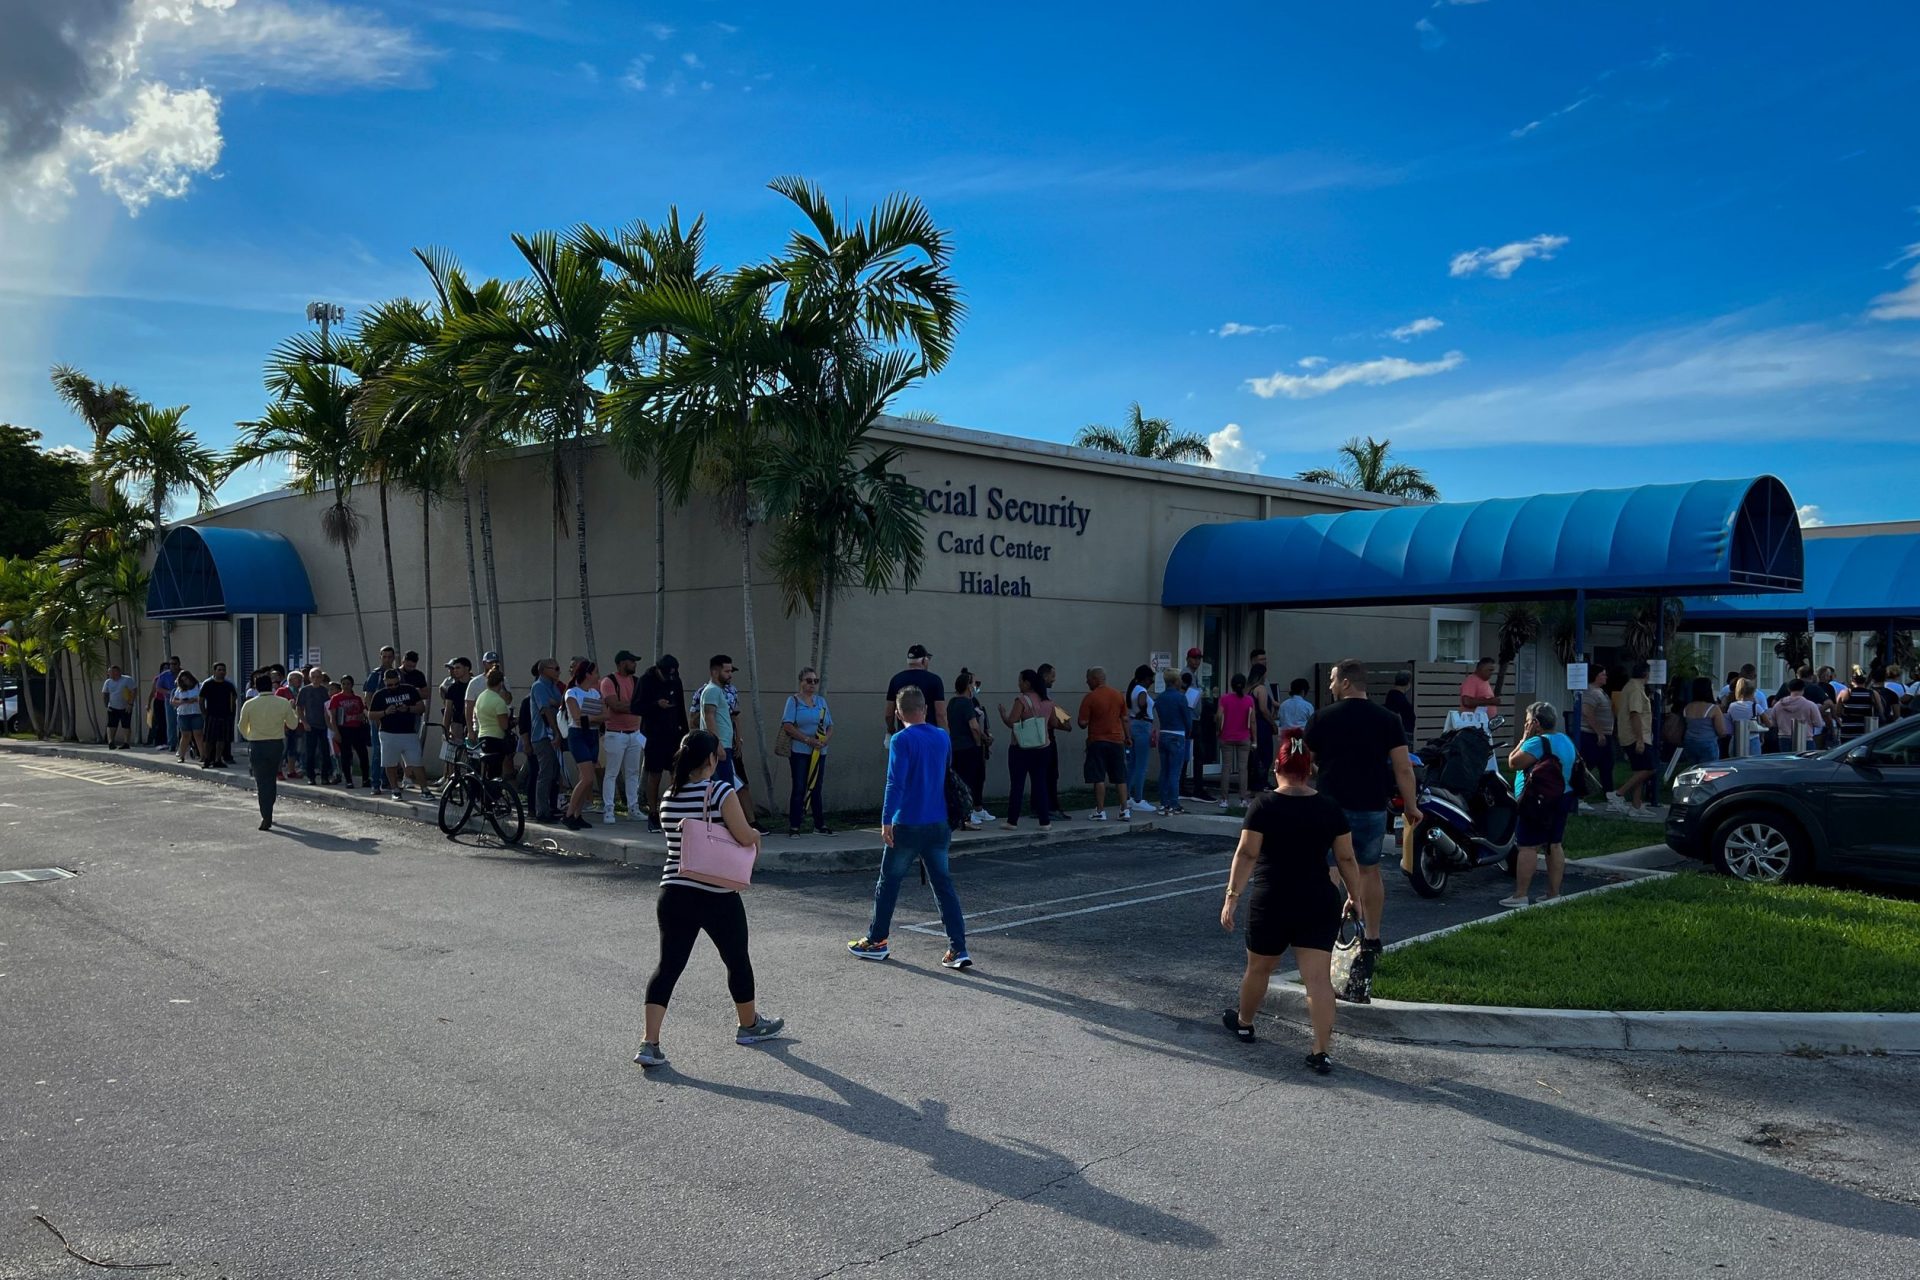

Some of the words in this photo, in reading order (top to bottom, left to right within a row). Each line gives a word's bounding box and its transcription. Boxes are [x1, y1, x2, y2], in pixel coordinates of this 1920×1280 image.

[919, 480, 978, 517] cial
[987, 487, 1091, 536] Security
[937, 530, 985, 555] Card
[990, 535, 1051, 561] Center
[959, 571, 1032, 597] Hialeah
